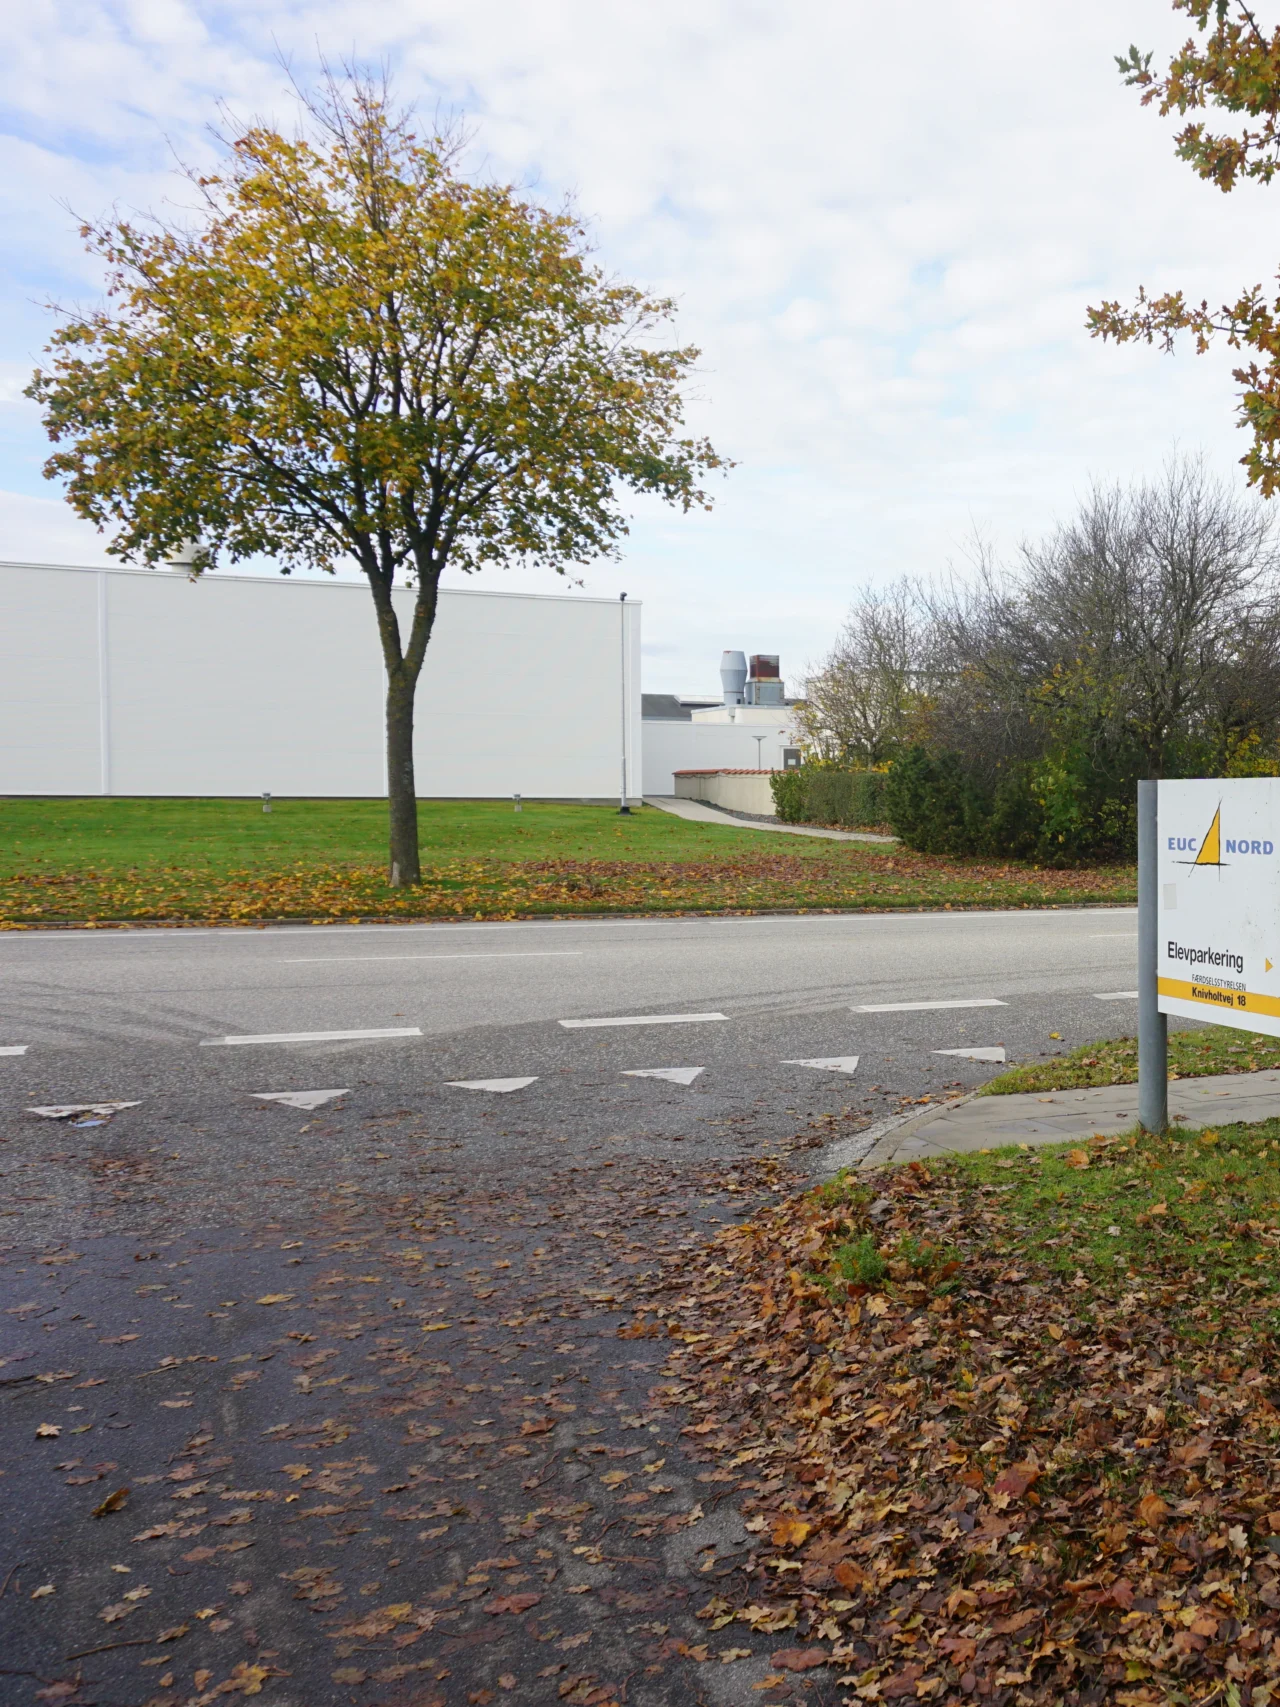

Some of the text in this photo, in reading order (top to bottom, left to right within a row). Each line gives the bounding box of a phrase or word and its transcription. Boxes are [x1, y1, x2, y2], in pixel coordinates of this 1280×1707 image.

[1167, 837, 1274, 855] EUC NORD
[1167, 940, 1244, 974] Elevparkering
[1191, 973, 1247, 992] FÆRDSELSSTYRELSEN
[1191, 986, 1247, 1007] Knivholtvej 18
